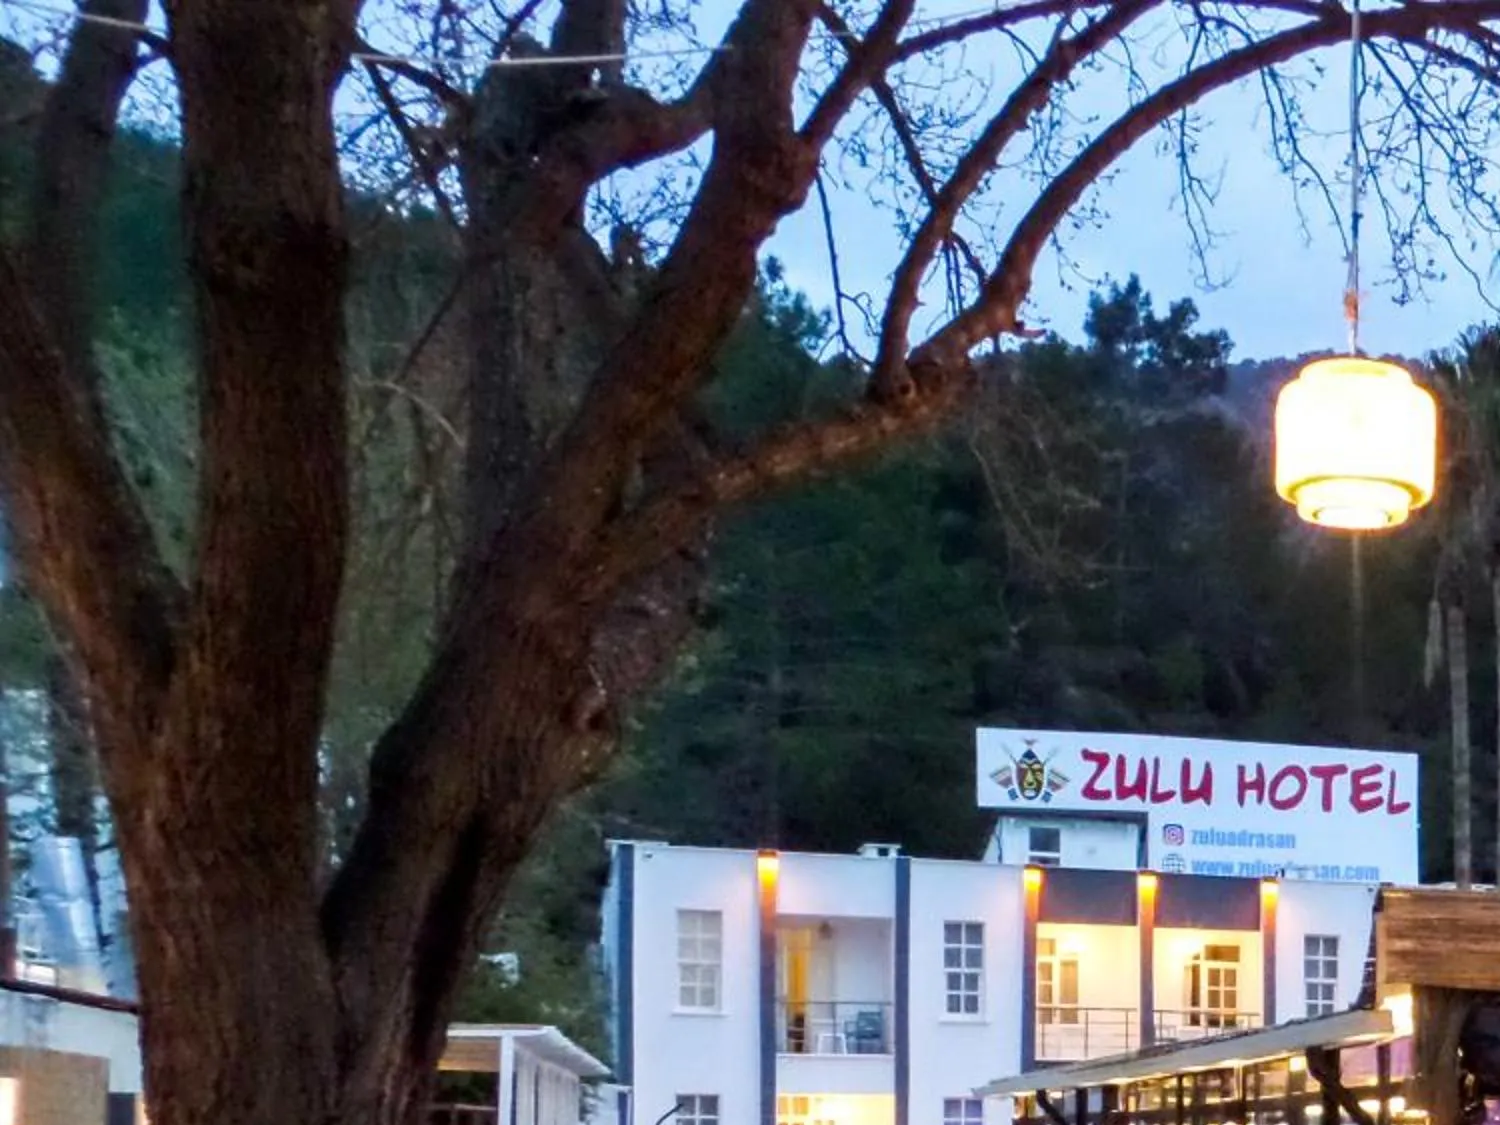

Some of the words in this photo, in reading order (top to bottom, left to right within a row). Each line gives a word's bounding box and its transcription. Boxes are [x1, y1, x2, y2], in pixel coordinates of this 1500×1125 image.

[1081, 748, 1213, 807] ZULU
[1237, 762, 1412, 815] HOTEL
[1190, 828, 1297, 849] zuluadrasan
